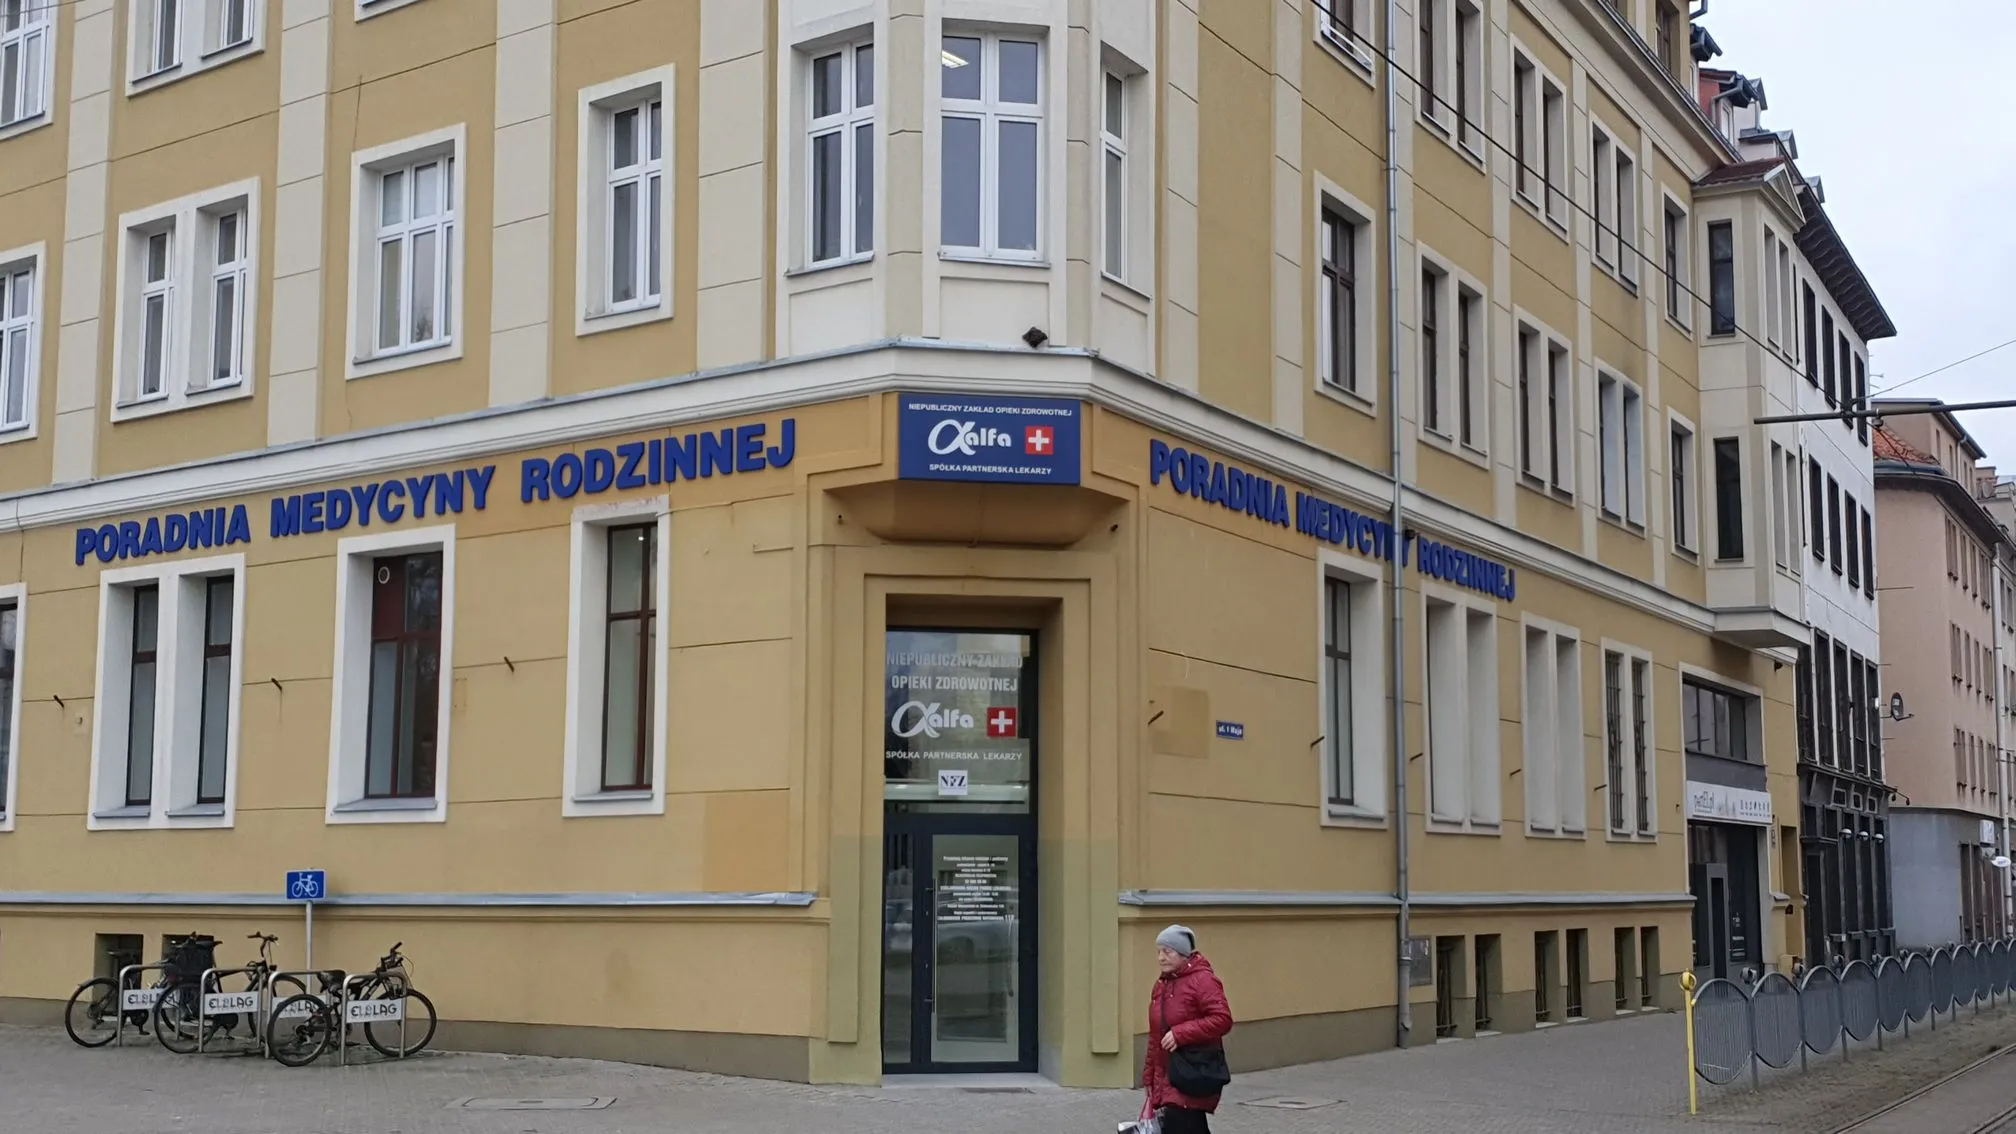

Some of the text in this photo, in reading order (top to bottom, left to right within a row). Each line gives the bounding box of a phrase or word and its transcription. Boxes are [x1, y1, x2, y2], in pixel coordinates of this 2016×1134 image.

[908, 403, 1072, 416] NIEPUBLICZNY ZAKŁAD OPIEKI ZDROWOTNEJ
[929, 463, 1052, 475] SPÓŁKA PARTNERSKA LEKARZY
[75, 418, 796, 565] PORADNIA MEDYCYNY RODZINNEJ
[1150, 438, 1290, 528] PORADNIA
[1417, 535, 1515, 601] RODZINNEJ
[887, 651, 973, 667] NIEPUBLICZNY
[892, 675, 1018, 691] OPIEKI ZDROWOTNEJ
[886, 750, 1022, 761] SPÓŁKA PARTNERSKA LEKARZY
[940, 775, 966, 787] NFZ
